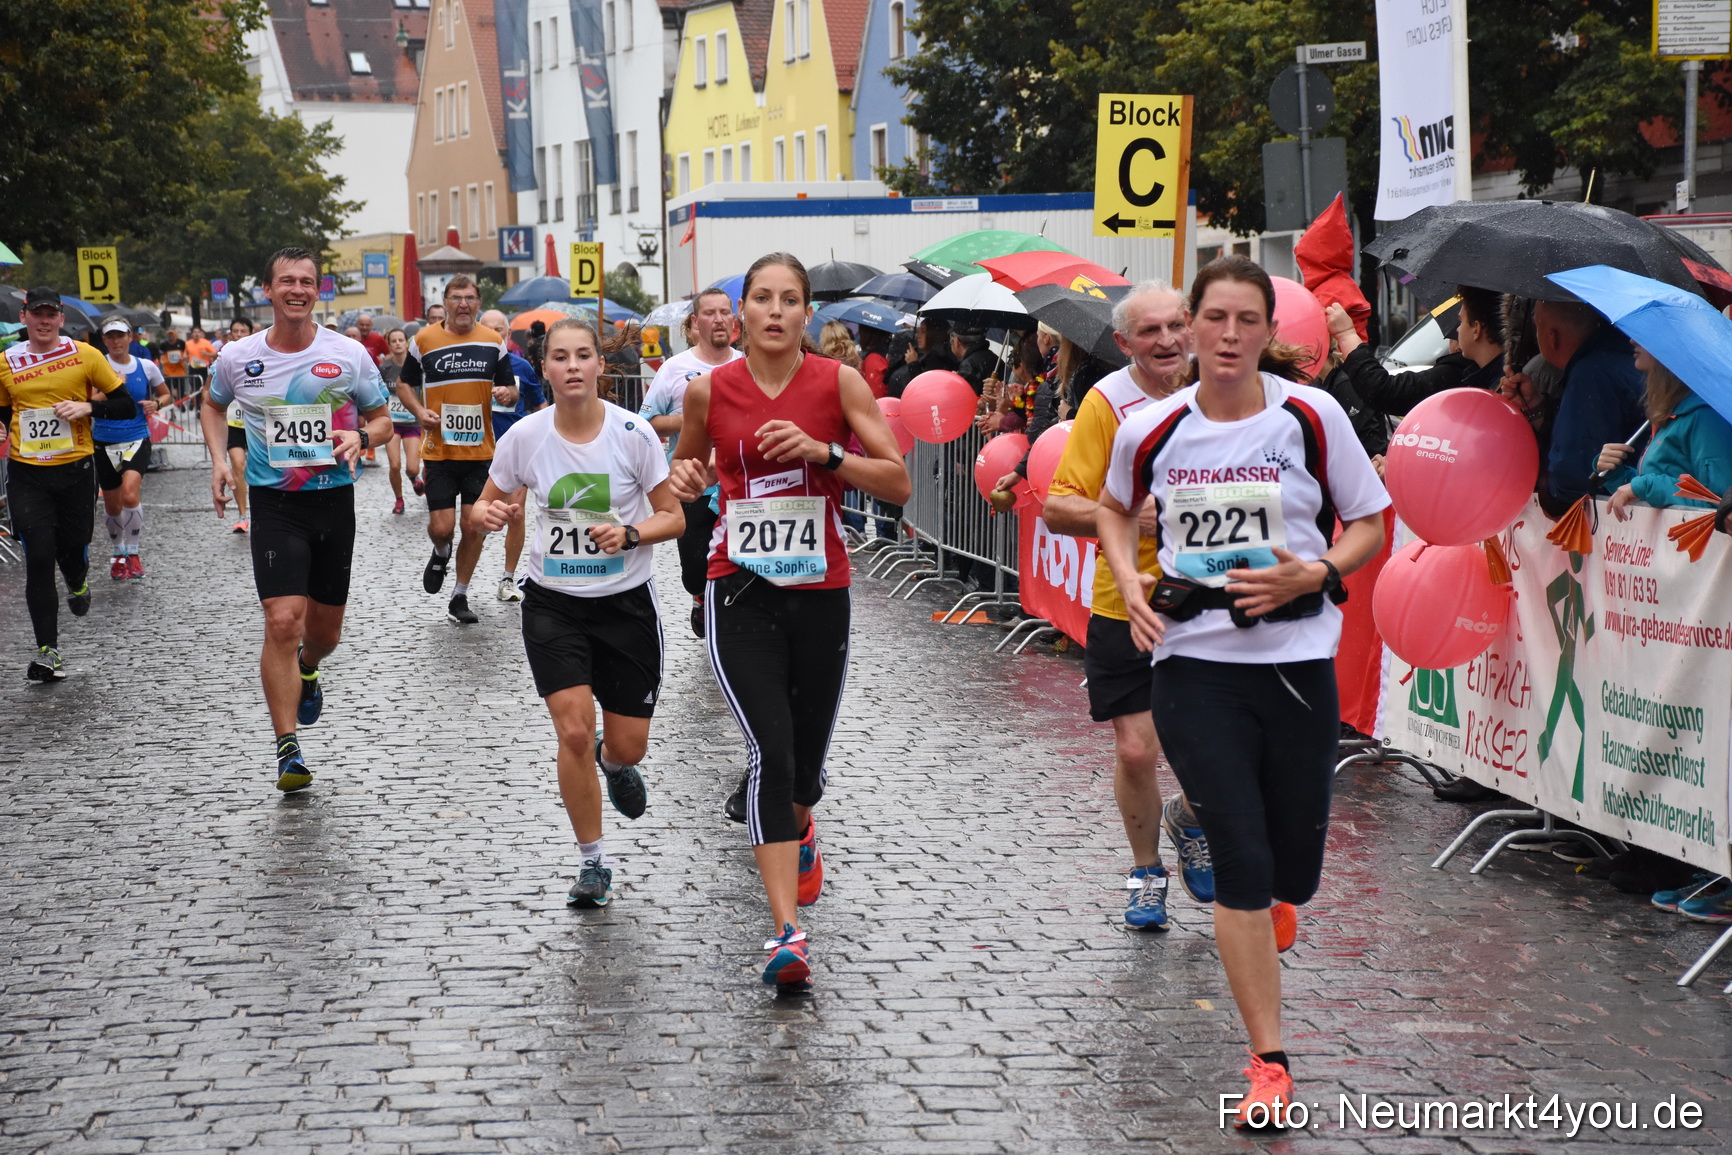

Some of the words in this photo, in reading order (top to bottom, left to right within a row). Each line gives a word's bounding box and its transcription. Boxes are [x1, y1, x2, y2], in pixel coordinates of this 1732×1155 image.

[1309, 48, 1334, 59] Ulmer
[1337, 46, 1362, 57] Gasse
[1110, 100, 1181, 126] Block
[708, 113, 730, 139] HOTEL
[1119, 137, 1166, 207] C
[82, 250, 112, 260] Block
[573, 244, 600, 254] Block
[89, 265, 109, 291] D
[579, 259, 595, 285] D
[13, 369, 44, 385] MAX
[47, 358, 83, 373] BÖGL
[444, 359, 488, 370] Fischer
[293, 406, 326, 414] BOCK
[29, 419, 61, 438] 322
[274, 420, 326, 443] 2493
[446, 415, 481, 430] 3000
[453, 431, 479, 442] OTTO
[39, 442, 52, 450] Jiri
[288, 449, 316, 458] Arnold
[1416, 449, 1455, 463] energie
[765, 477, 788, 488] DEHN
[1167, 467, 1280, 485] SPARKASSEN
[1214, 486, 1269, 499] BOCK
[771, 500, 816, 511] BOCK
[739, 519, 817, 553] 2074
[1180, 507, 1269, 547] 2221
[549, 526, 601, 555] 213
[1604, 535, 1654, 568] Service-Line:
[561, 563, 607, 575] Ramona
[775, 560, 817, 577] Sophie
[1602, 680, 1704, 744] Gebäudereinigung
[1602, 731, 1706, 789] Hausmeisterdienst
[1603, 781, 1715, 847] Arbeitsbühnenverleih
